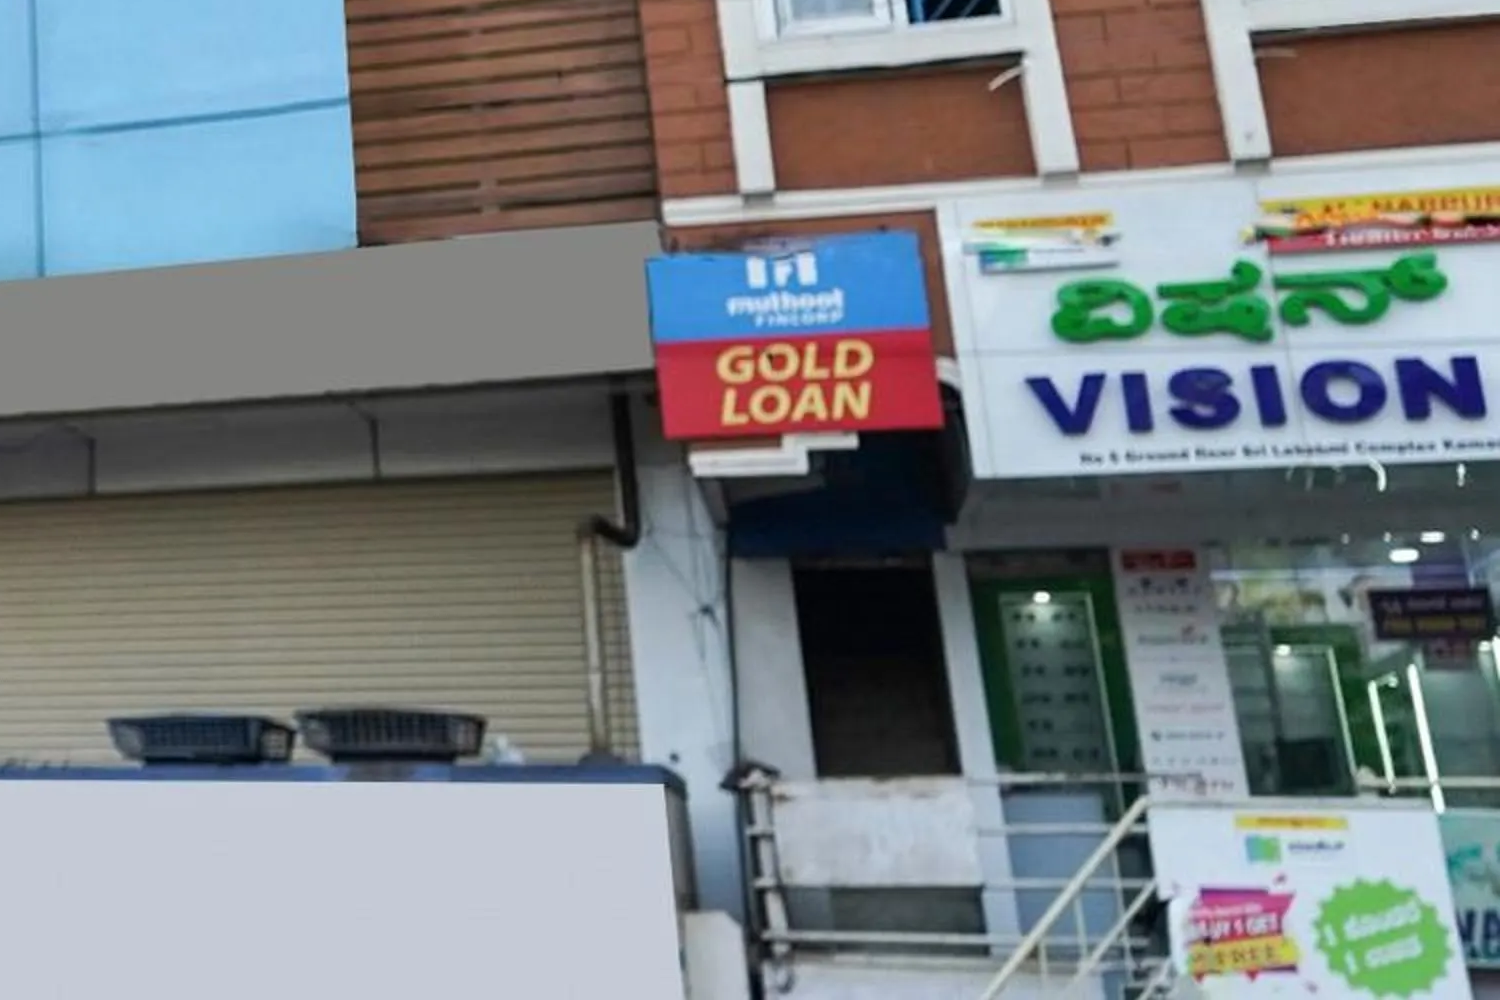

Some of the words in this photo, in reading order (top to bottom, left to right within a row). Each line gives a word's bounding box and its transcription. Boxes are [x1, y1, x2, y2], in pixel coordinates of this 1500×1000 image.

[716, 339, 875, 384] GOLD
[721, 381, 872, 426] LOAN
[1024, 356, 1487, 436] VISION
